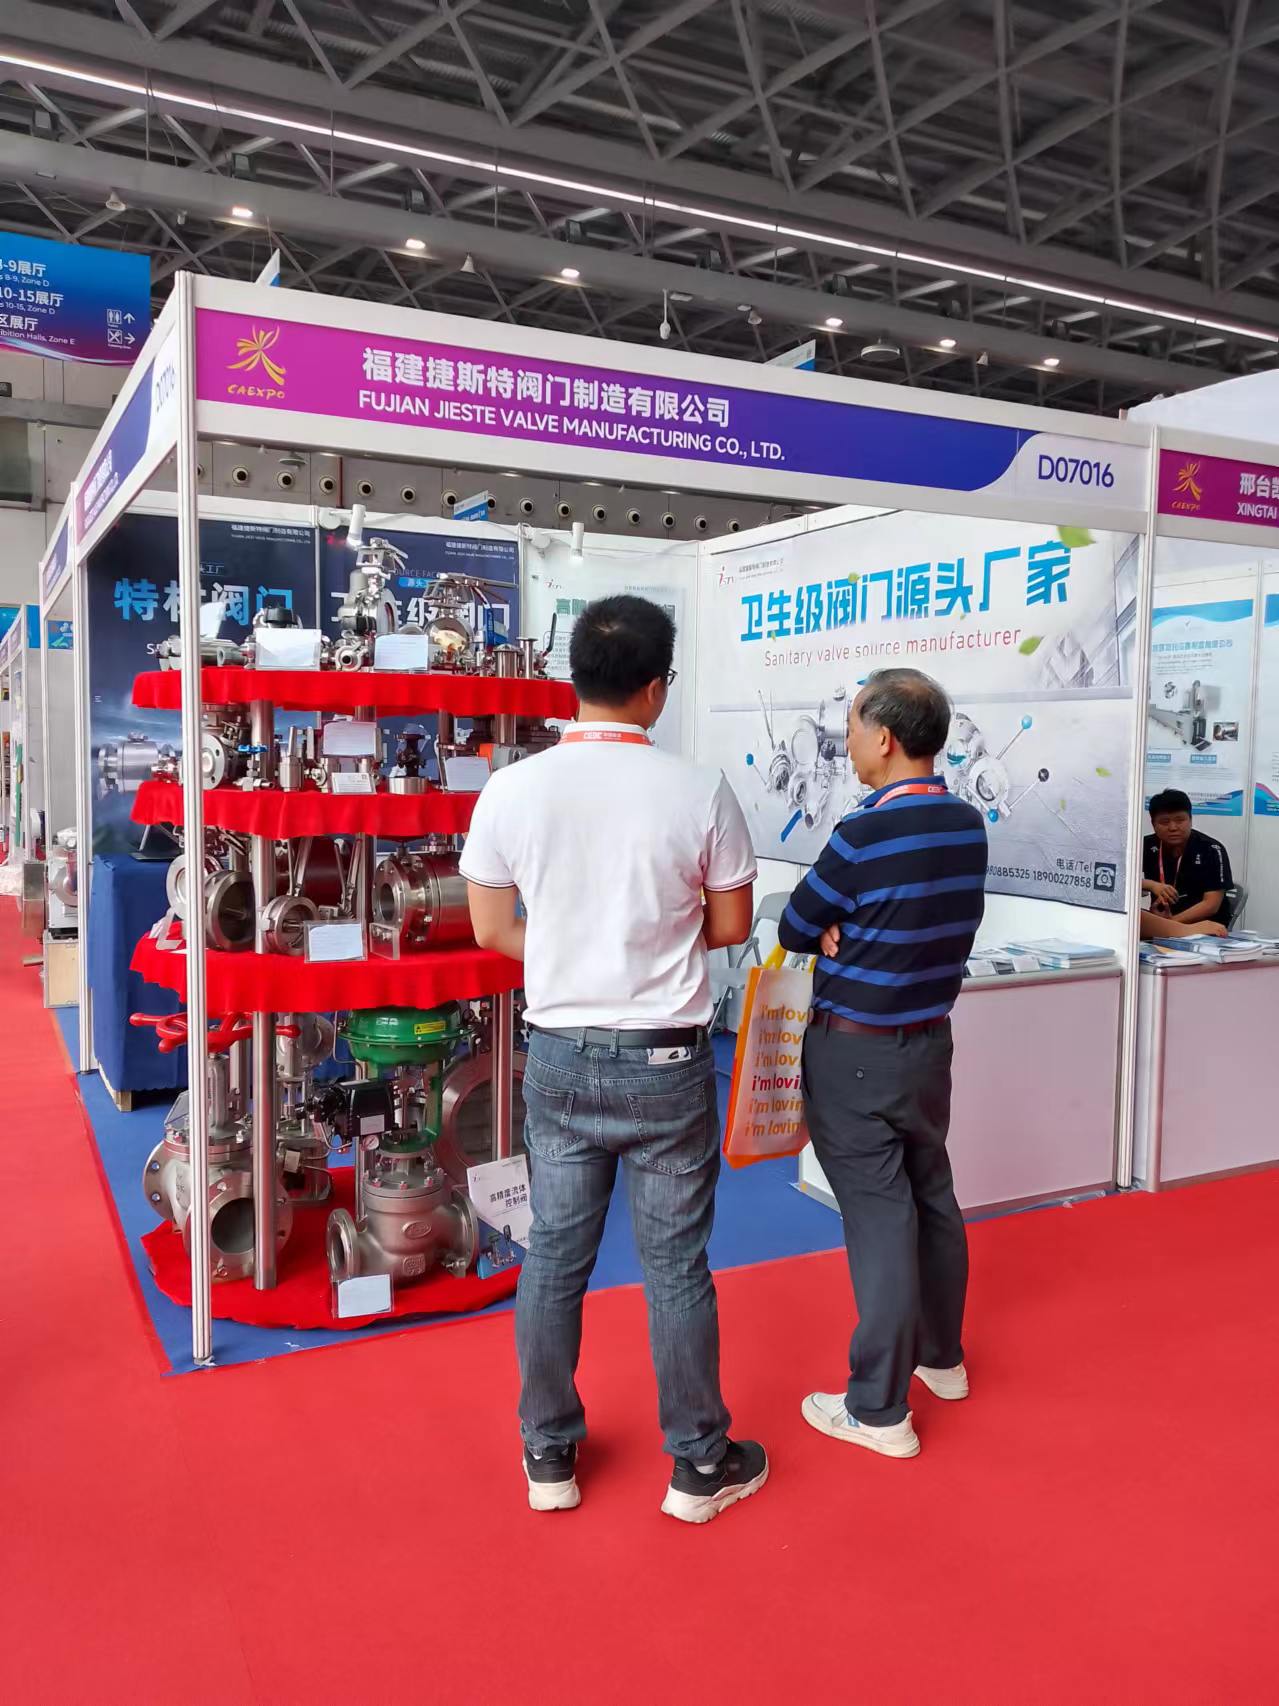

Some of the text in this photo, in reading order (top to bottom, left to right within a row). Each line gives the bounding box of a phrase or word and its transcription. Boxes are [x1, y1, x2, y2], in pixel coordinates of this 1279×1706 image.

[22, 276, 41, 286] Zone
[27, 304, 47, 314] Zone
[0, 313, 38, 331] 区展厅
[0, 328, 25, 338] ibition
[49, 335, 68, 344] Zone
[227, 383, 286, 400] CAEXPO
[362, 346, 731, 428] 福建捷斯特阀门制造有限公司
[359, 389, 786, 461] FUJIAN JIESTE VALVE MANUFACTURING CO., LTD.
[1038, 454, 1115, 488] D07016
[1236, 502, 1277, 519] XINGTAI
[740, 540, 1073, 642] 卫生级阀门源头厂家
[764, 628, 1022, 667] Sanitary valve source manufacturer
[1033, 870, 1092, 888] 18900227858
[780, 1003, 807, 1022] lov
[777, 1027, 802, 1044] lov
[774, 1050, 802, 1066] lov
[752, 1073, 802, 1091] i'm lovi
[744, 1120, 765, 1136] i'm
